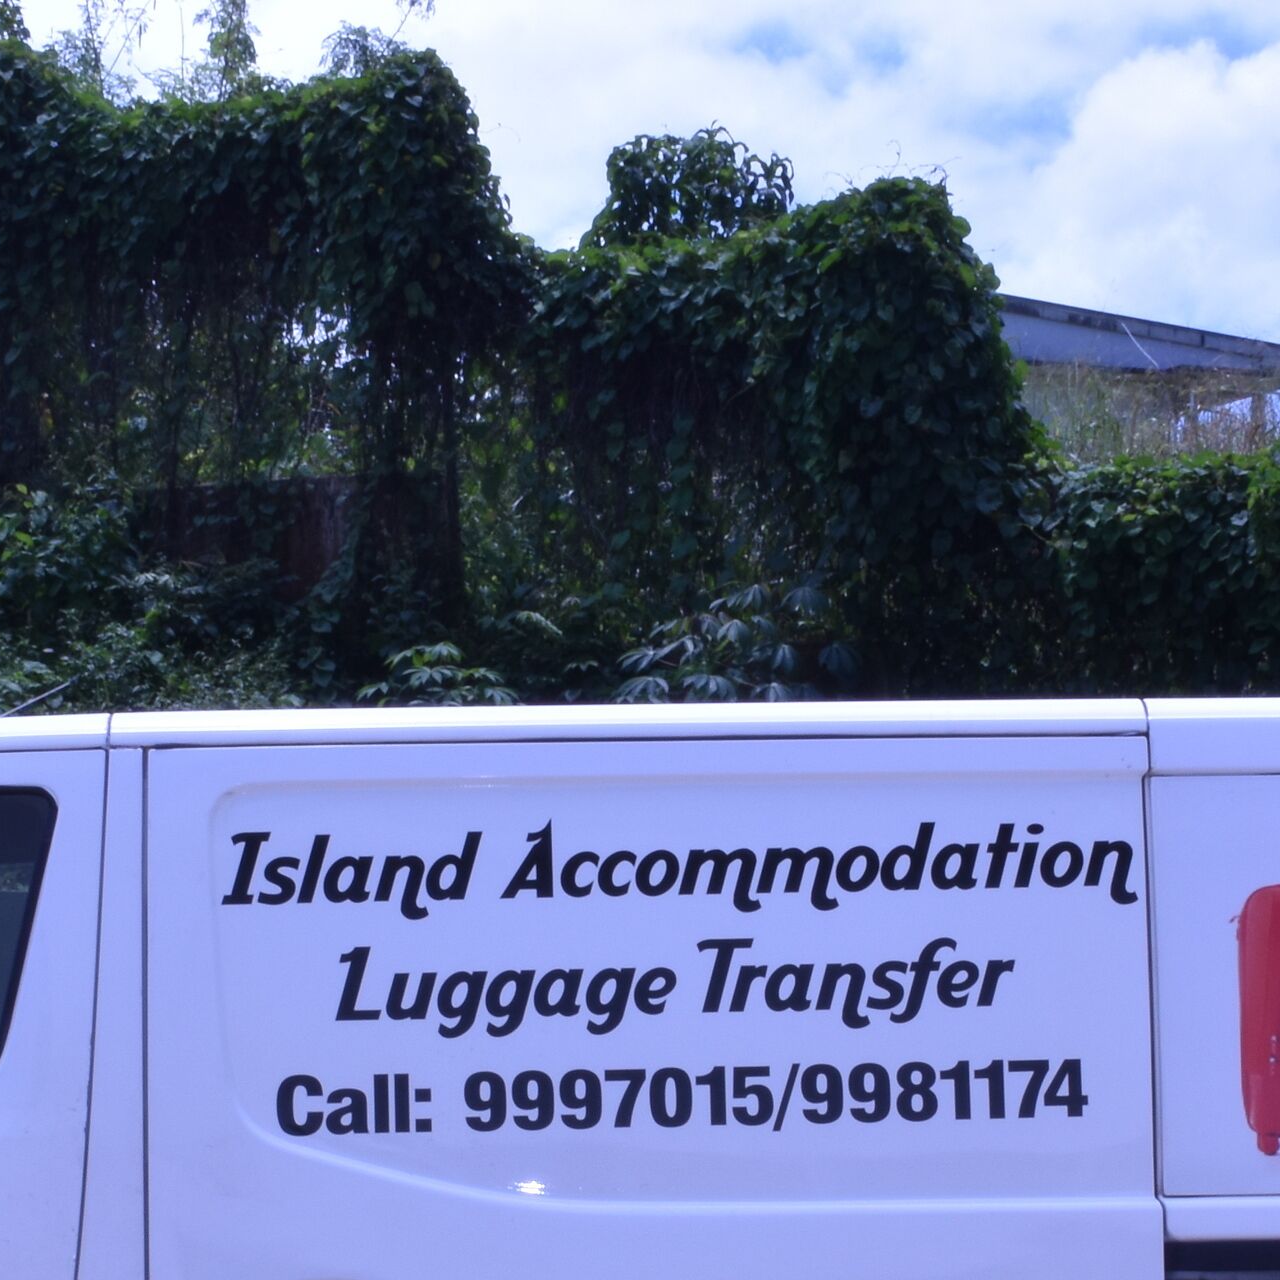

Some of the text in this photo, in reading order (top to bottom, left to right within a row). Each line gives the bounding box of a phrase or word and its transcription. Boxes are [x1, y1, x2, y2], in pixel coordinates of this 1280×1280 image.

[221, 819, 1139, 921] Island Accommodation
[335, 937, 1016, 1039] Luggage Transfer
[276, 1058, 1089, 1137] Call: 9997015/9981174
